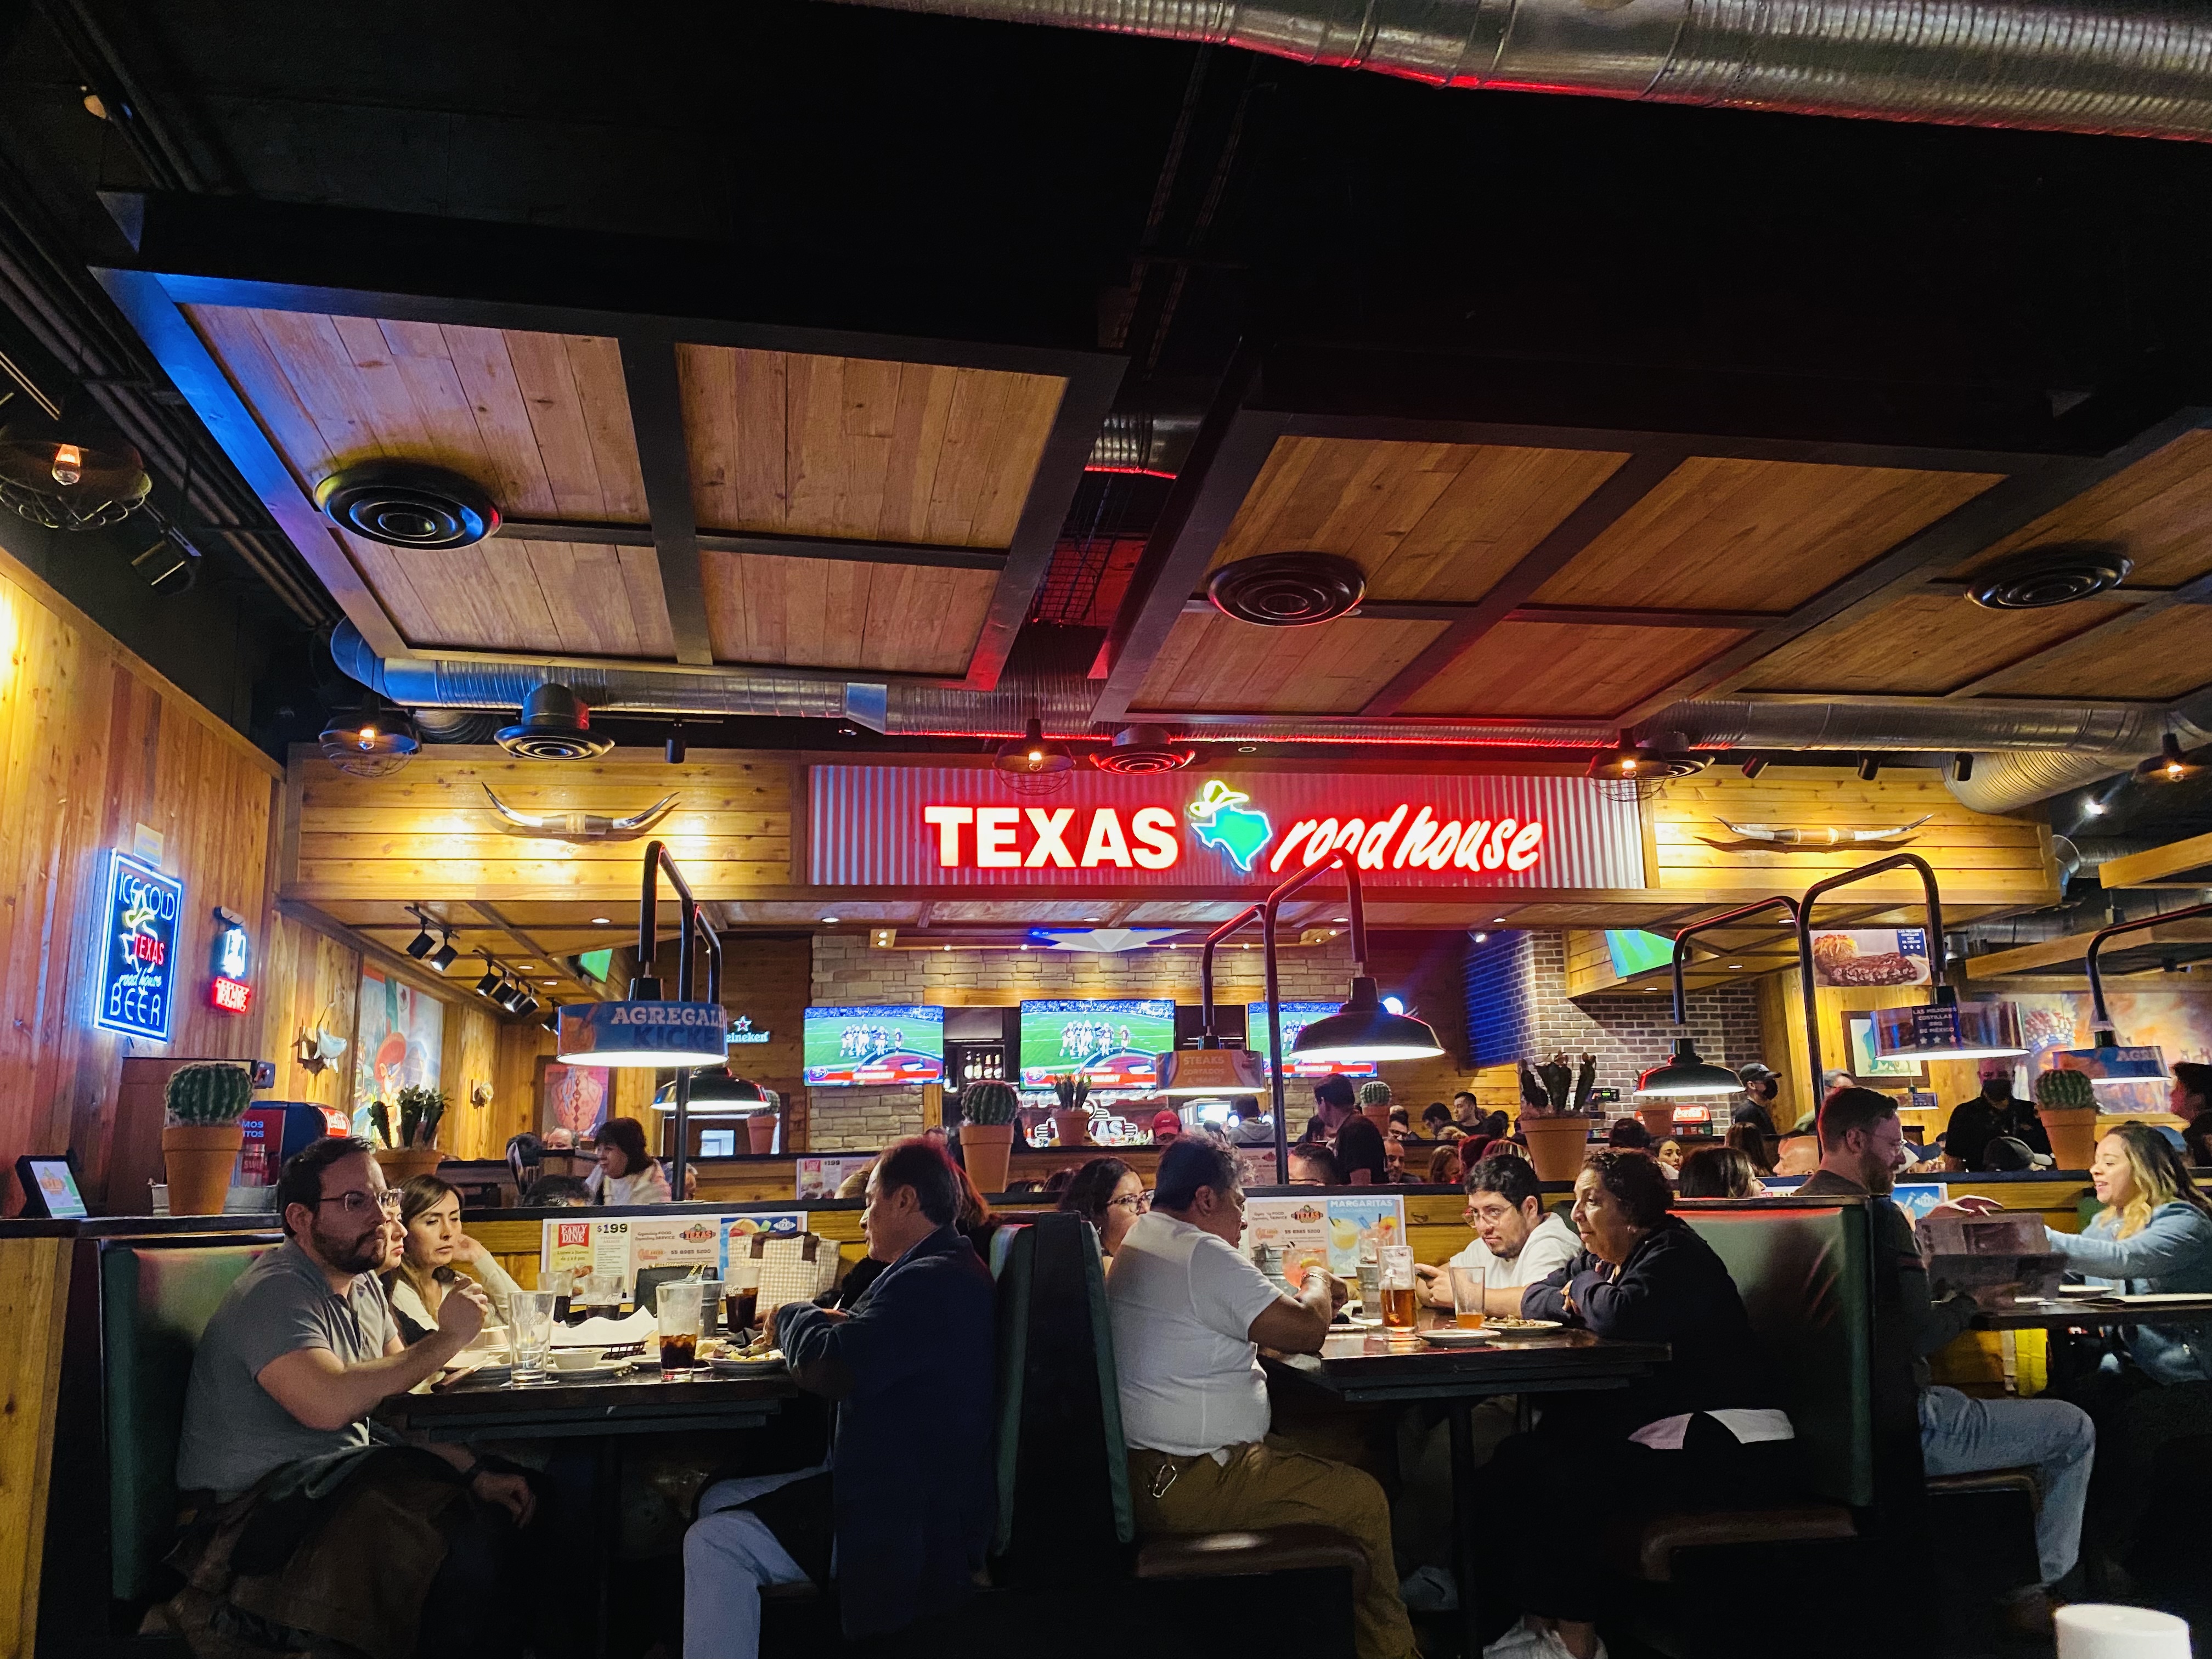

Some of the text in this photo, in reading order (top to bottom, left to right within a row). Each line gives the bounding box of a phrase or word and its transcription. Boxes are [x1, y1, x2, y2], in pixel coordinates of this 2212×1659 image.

[924, 806, 1179, 869] TEXAS
[119, 871, 176, 921] ICE COLD
[134, 933, 165, 966] TEXAS
[110, 983, 161, 1026] BEER
[726, 1031, 770, 1042] eineken
[1183, 1056, 1225, 1065] STEAKS
[241, 1120, 264, 1128] MOS
[1330, 1199, 1393, 1207] MARGARITAS
[1295, 1211, 1321, 1220] TEXAS
[561, 1224, 588, 1234] EARLY
[597, 1223, 628, 1233] $199
[562, 1233, 585, 1244] DINE
[685, 1230, 712, 1240] TEXAS
